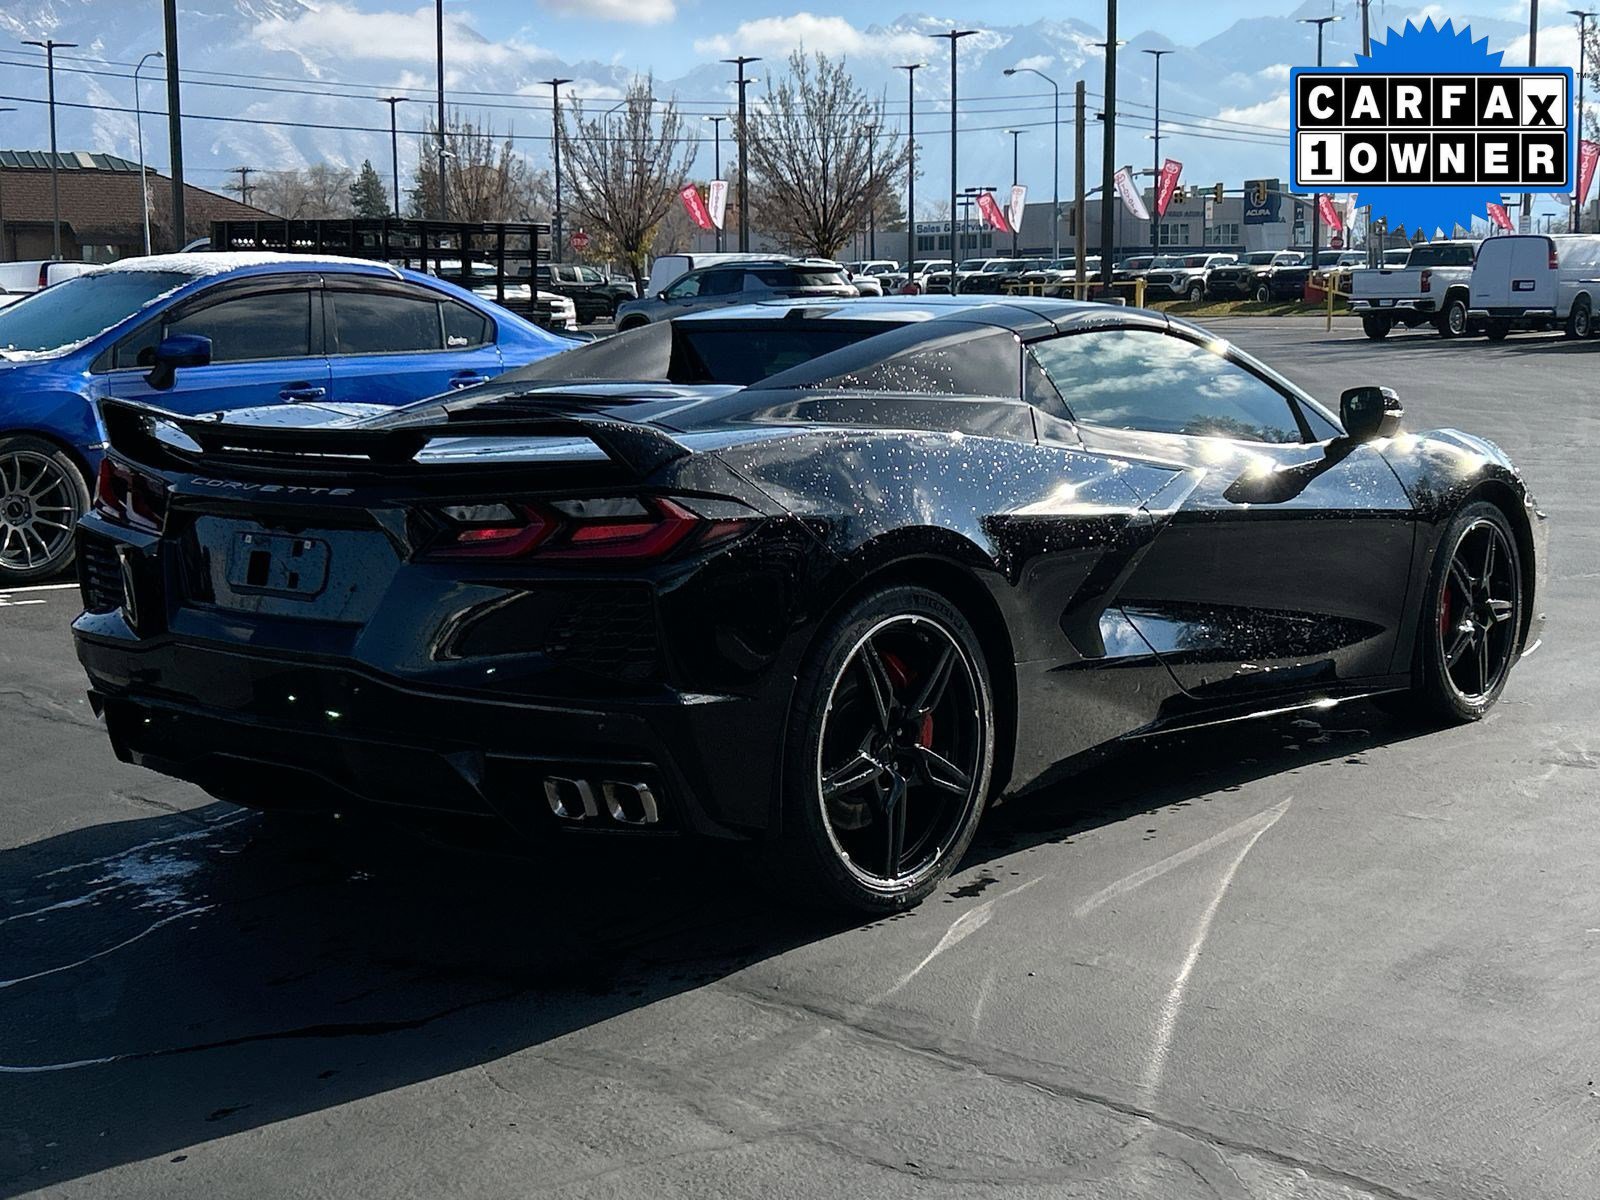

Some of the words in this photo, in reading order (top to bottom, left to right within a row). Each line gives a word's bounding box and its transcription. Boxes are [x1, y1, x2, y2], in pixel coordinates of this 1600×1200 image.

[1246, 209, 1271, 217] ACURA
[916, 224, 940, 234] Sales
[190, 477, 355, 496] CORVETTE
